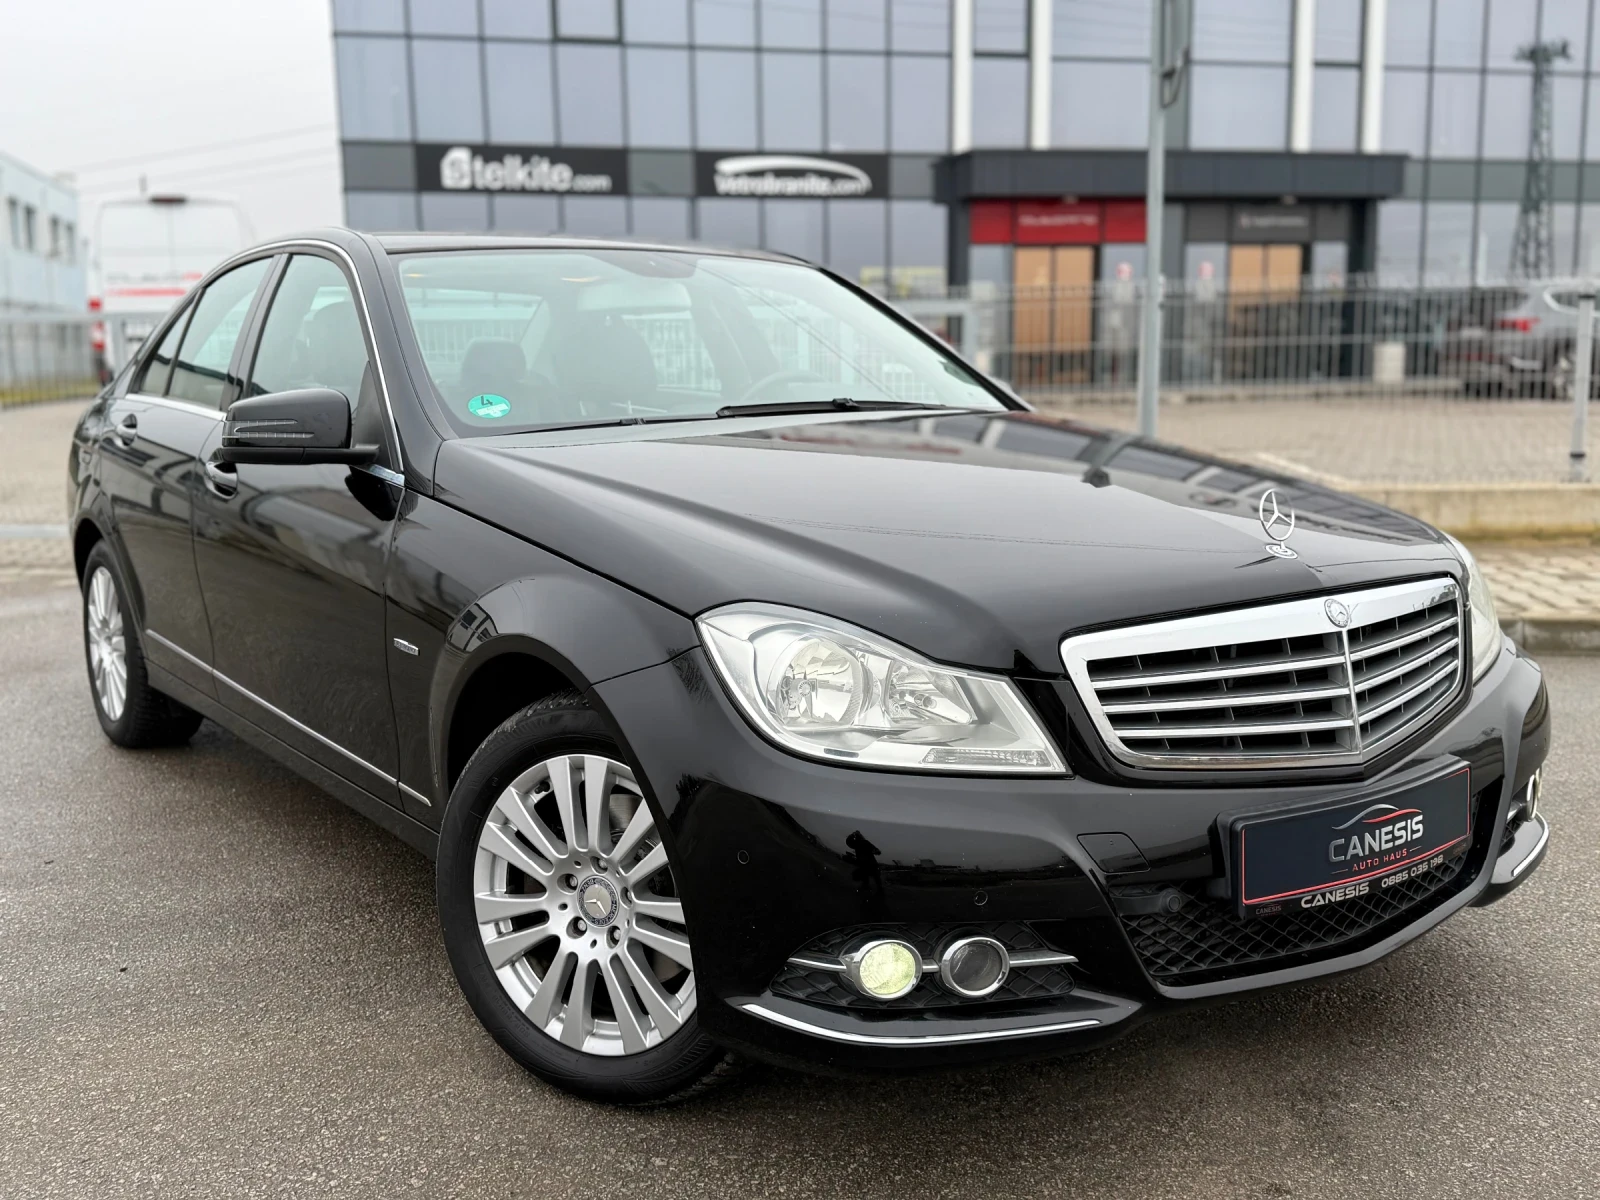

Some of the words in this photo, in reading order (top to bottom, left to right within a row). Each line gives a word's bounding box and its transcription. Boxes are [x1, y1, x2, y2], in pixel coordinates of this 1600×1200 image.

[1329, 815, 1423, 862] CANESIS
[1352, 858, 1379, 871] AUTO
[1383, 849, 1407, 862] HAUS
[1301, 882, 1369, 908] CANESIS
[1381, 870, 1408, 888] 0885
[1410, 862, 1428, 877] 035
[1430, 854, 1444, 868] 198
[1255, 905, 1282, 915] CANESIS
